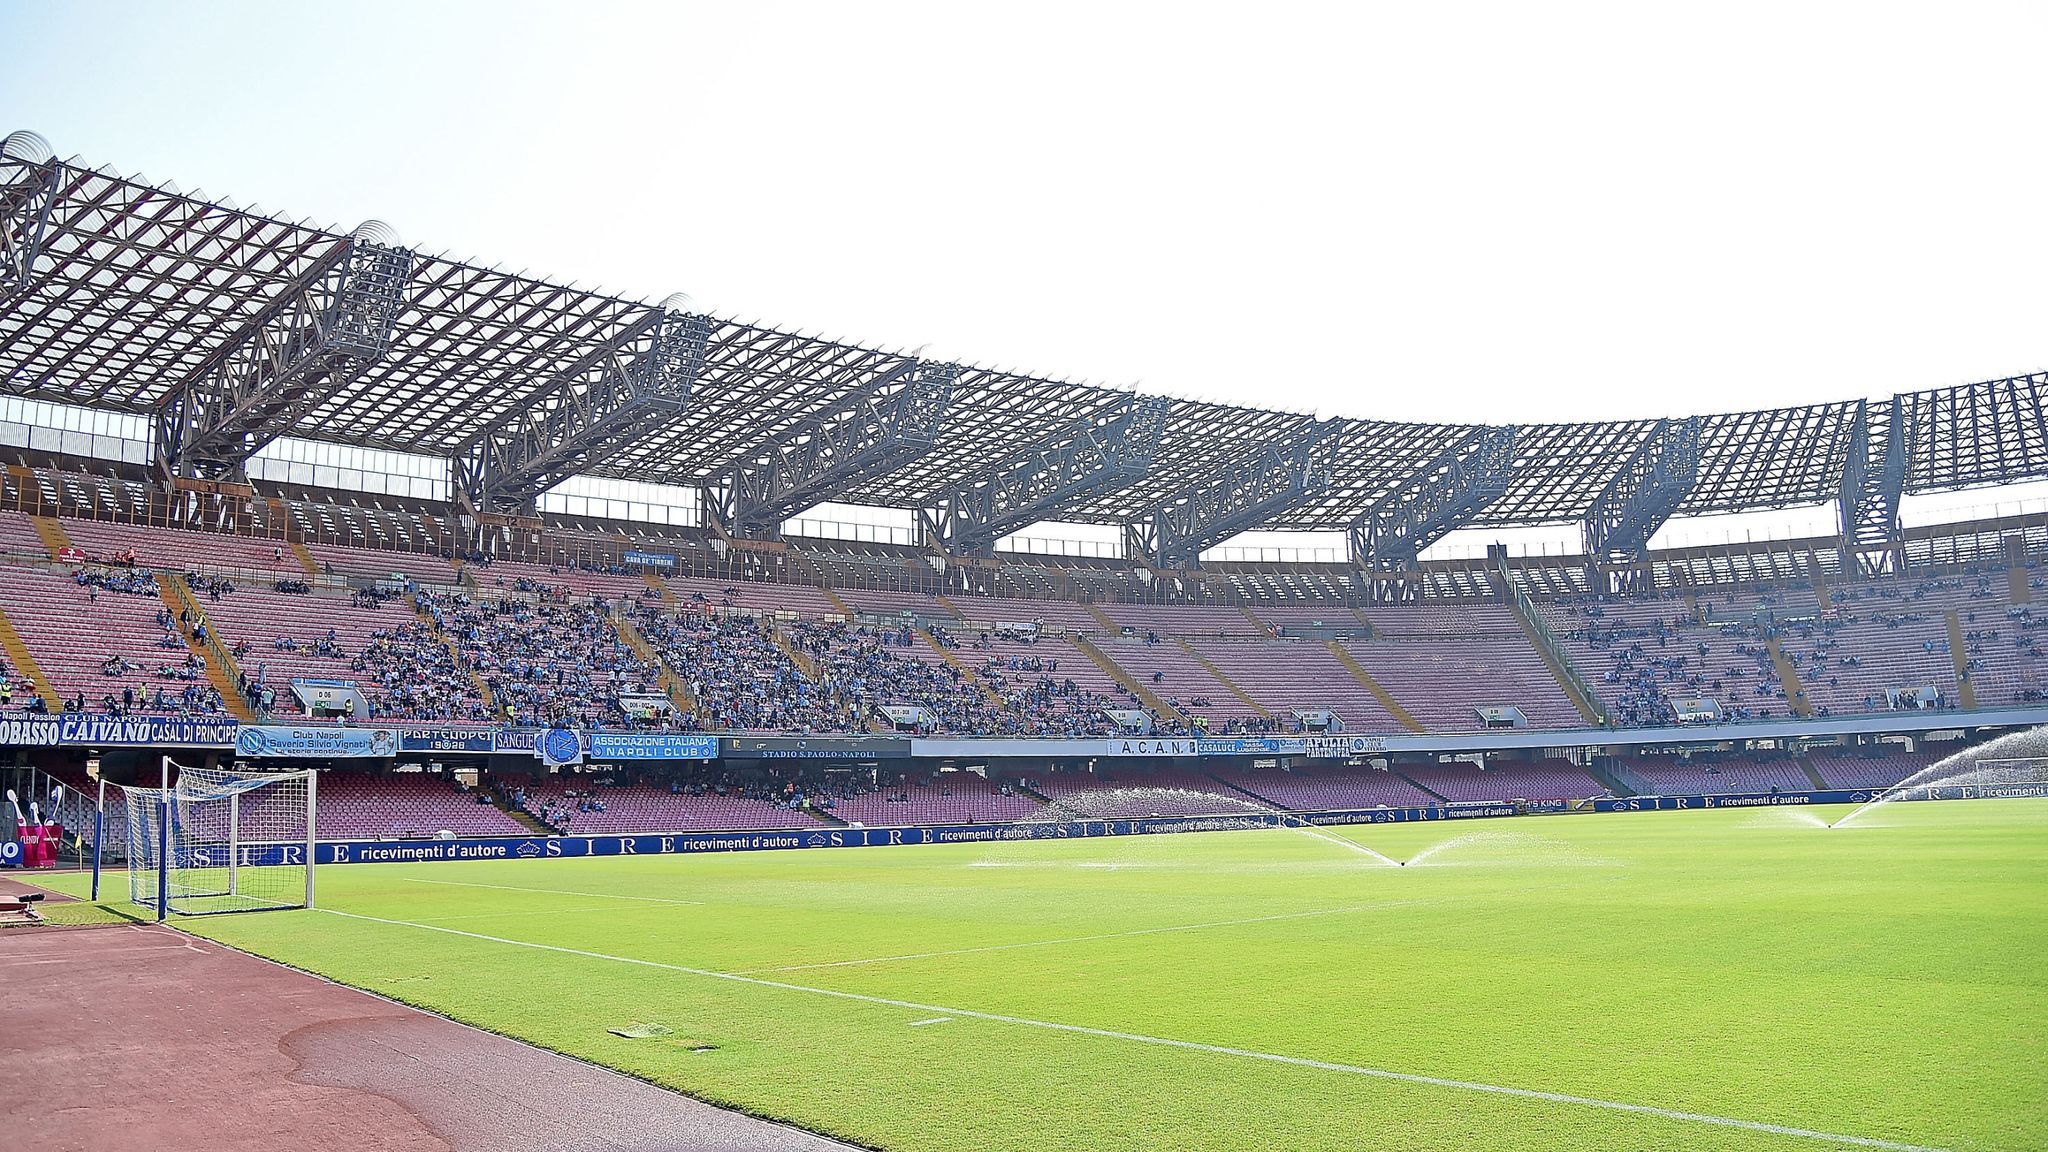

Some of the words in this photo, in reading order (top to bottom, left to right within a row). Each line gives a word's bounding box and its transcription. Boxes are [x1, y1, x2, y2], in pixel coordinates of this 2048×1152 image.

[2, 711, 28, 720] Napoli
[29, 713, 60, 721] Passion
[65, 714, 99, 722] CLUB
[0, 721, 59, 745] OBASSO
[61, 721, 151, 742] CAIVANO
[151, 723, 181, 742] CASAL
[183, 725, 193, 742] DI
[196, 725, 236, 743] PRINCIPE
[292, 731, 313, 739] Club
[316, 731, 345, 741] Napoli
[307, 739, 331, 748] Silvio
[497, 733, 534, 748] SANGUE
[594, 737, 665, 746] ASSOCIAZIONE
[667, 737, 709, 746] ITALIANA
[606, 747, 657, 756] NAPOLI
[664, 748, 698, 756] CLUB
[1198, 744, 1236, 752] CASALUCE
[1982, 786, 2044, 796] ricevimenti
[1630, 797, 1715, 810] SIRE
[1720, 797, 1770, 806] ricevimenti
[1772, 795, 1809, 804] d'autore
[1310, 815, 1345, 825] ricevimenti
[1346, 814, 1372, 823] d'autore
[1387, 809, 1445, 821] SIRE
[1448, 809, 1483, 818] ricevimenti
[1484, 807, 1513, 816] d'autore
[830, 829, 933, 847] SIRE
[940, 828, 993, 841] ricevimenti
[995, 828, 1032, 839] d'autore
[361, 844, 443, 859] ricevimenti
[447, 844, 506, 857] d'autore
[546, 837, 675, 857] SIRE
[683, 837, 749, 850] ricevimenti
[752, 836, 799, 848] d'autore
